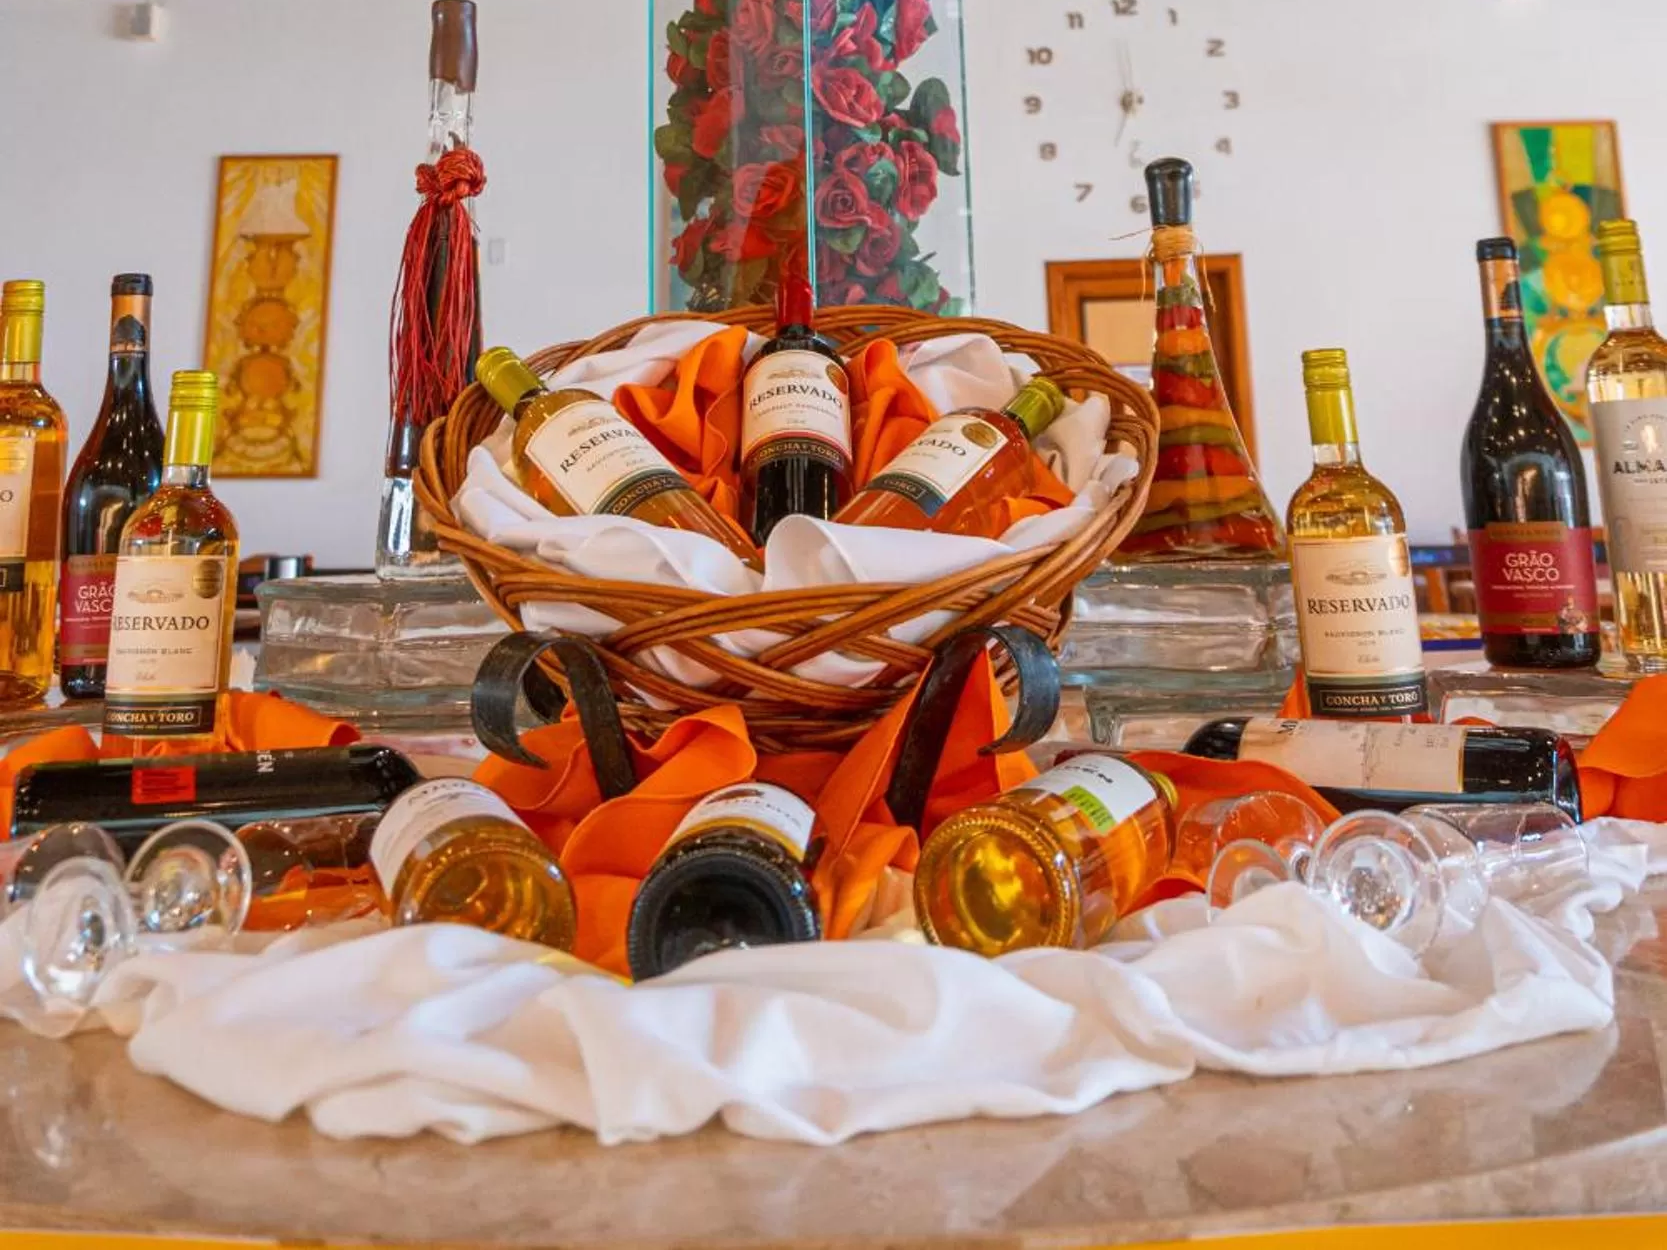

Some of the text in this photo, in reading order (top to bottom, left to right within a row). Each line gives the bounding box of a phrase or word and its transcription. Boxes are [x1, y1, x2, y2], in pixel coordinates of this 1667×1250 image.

[1066, 12, 1084, 30] 11
[1168, 8, 1178, 26] 1
[1026, 47, 1053, 65] 10
[1206, 39, 1225, 57] 2
[1023, 96, 1042, 114] 9
[1223, 90, 1240, 110] 3
[1074, 183, 1093, 202] 7
[749, 384, 843, 411] RESERVADO
[560, 429, 640, 473] RESERVA
[1504, 549, 1554, 568] GRÃO
[1501, 567, 1560, 582] VASCO
[74, 598, 113, 613] VASC
[1308, 594, 1410, 616] RESERVADO
[1327, 696, 1380, 707] CONCHA
[1388, 691, 1418, 704] TORO
[158, 712, 194, 723] TORO
